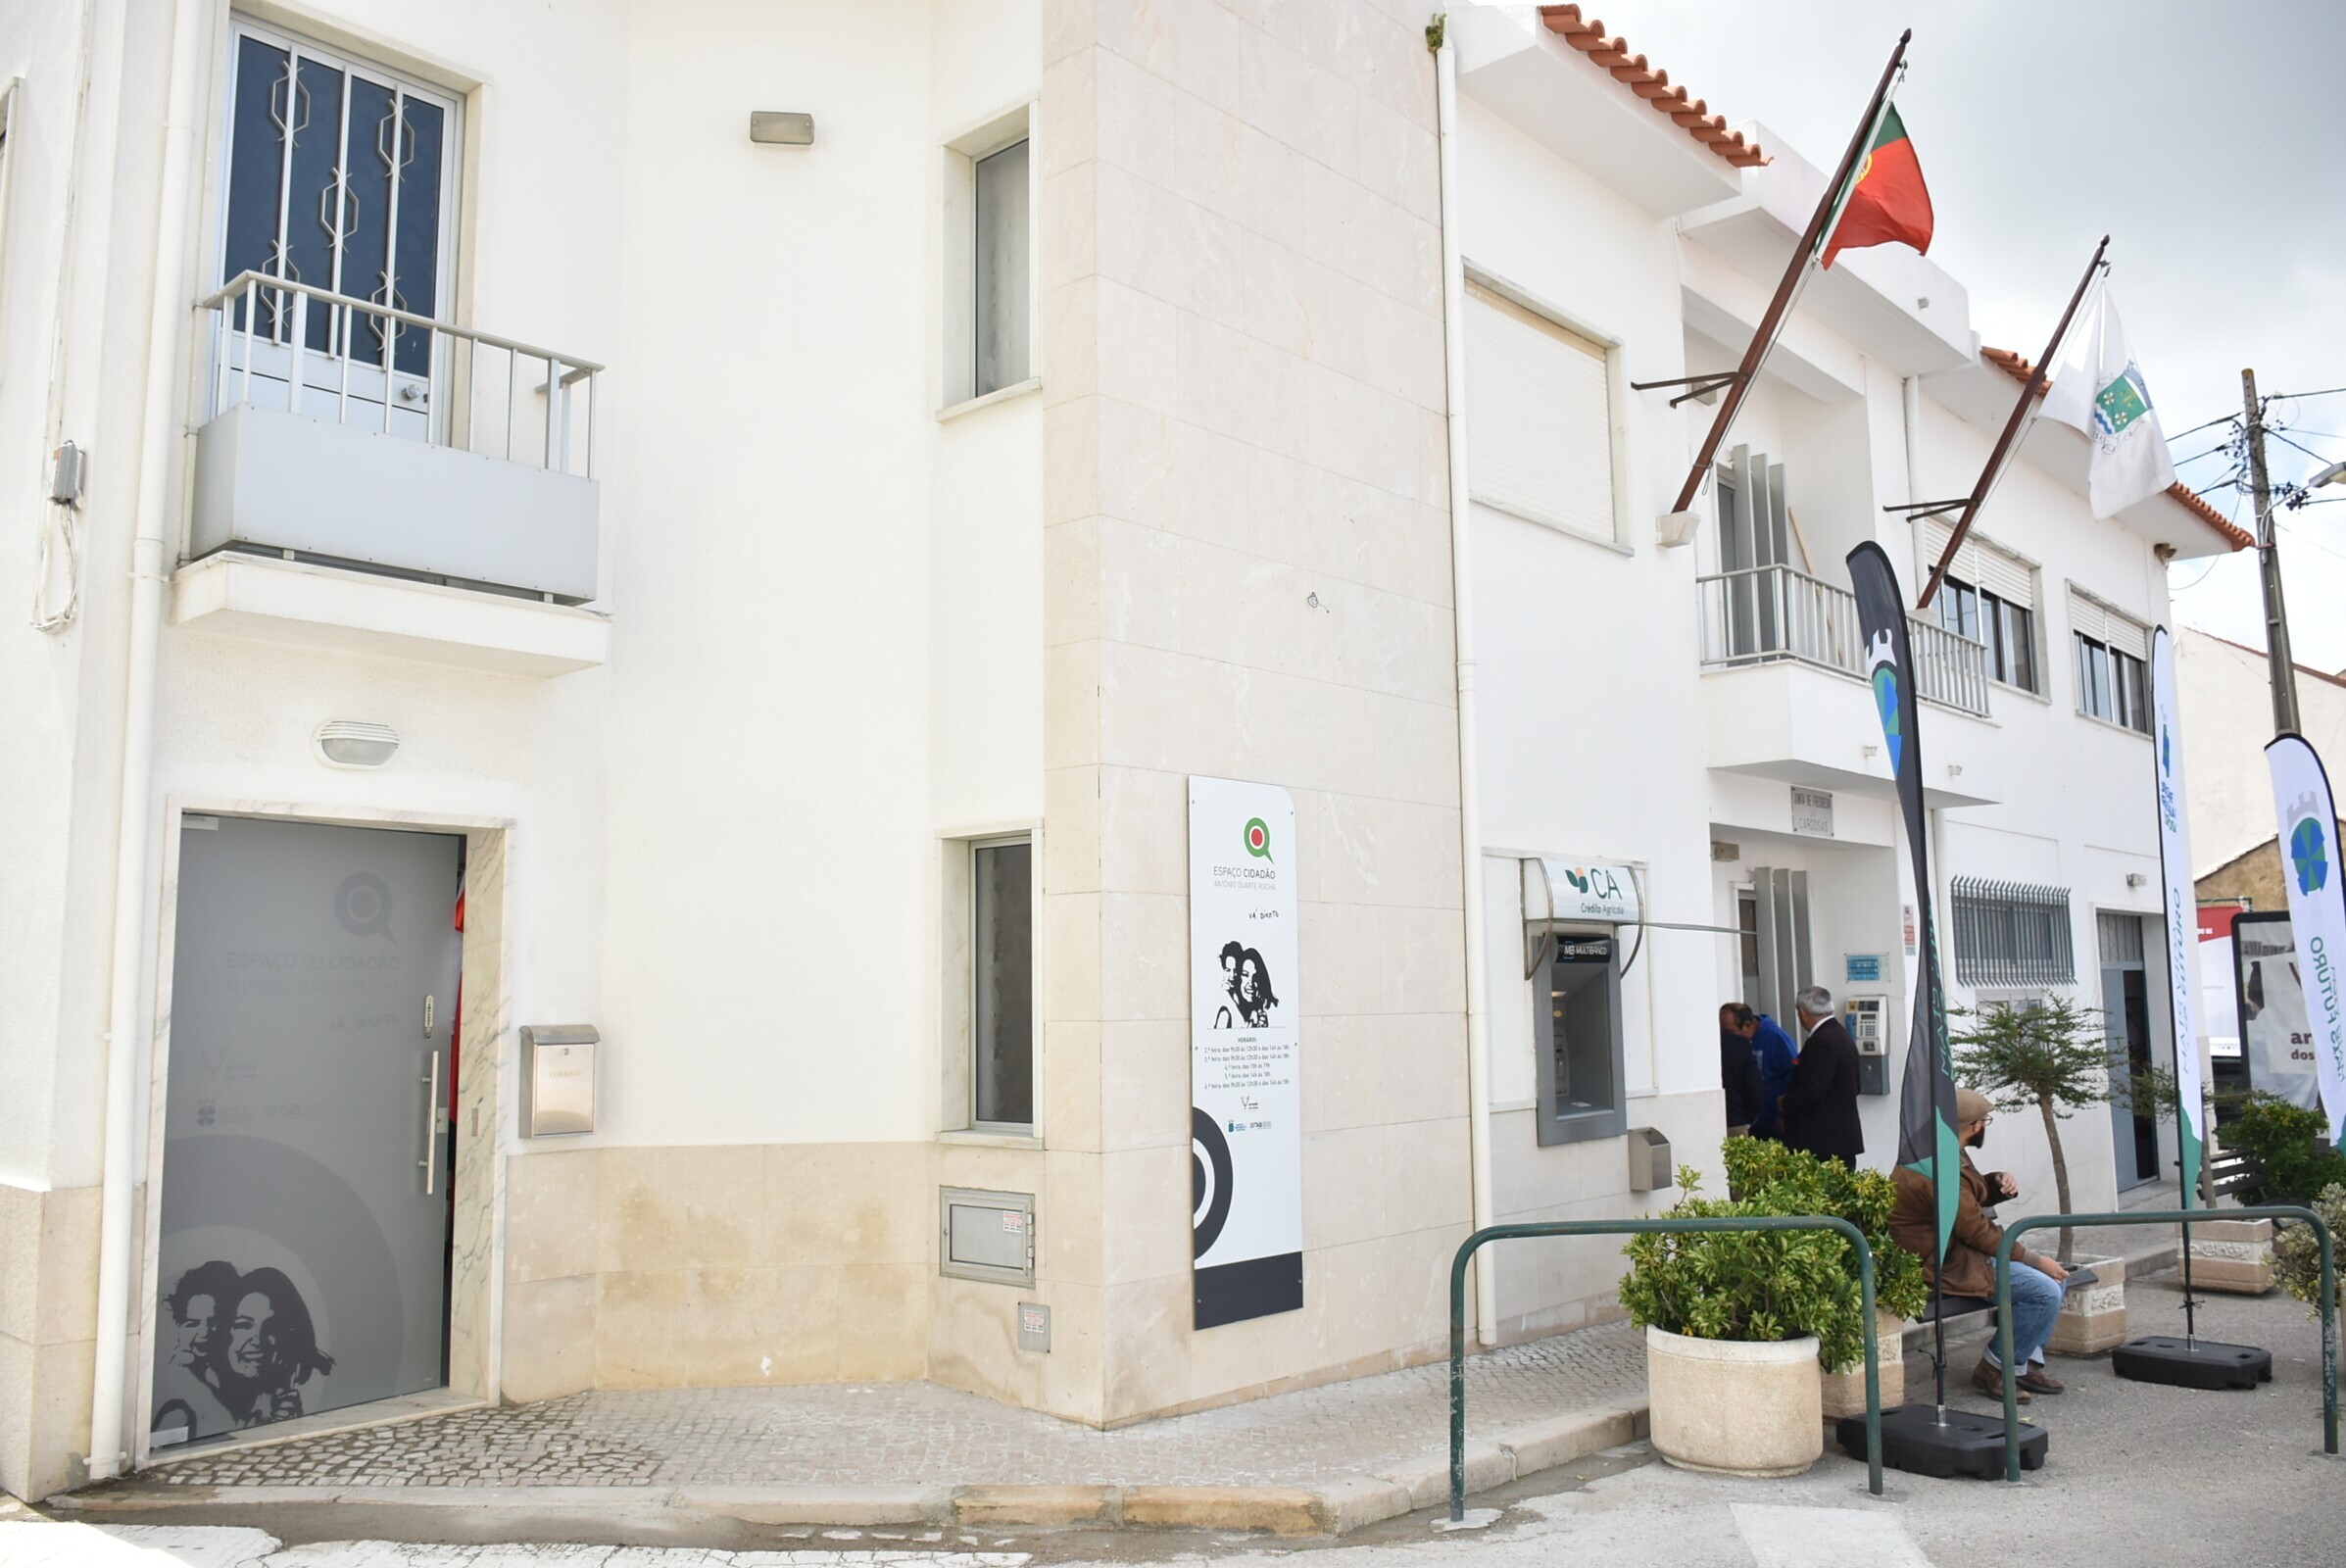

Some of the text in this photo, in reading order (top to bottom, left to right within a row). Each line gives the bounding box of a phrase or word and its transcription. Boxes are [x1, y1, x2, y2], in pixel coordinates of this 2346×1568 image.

[1213, 866, 1276, 880] ESPAÇO CIDADÃO
[1590, 868, 1623, 900] CA
[1575, 946, 1607, 956] MULTIBANCO
[225, 952, 401, 972] ESPAÇO DO CIDADÃO
[2291, 1050, 2315, 1060] dos
